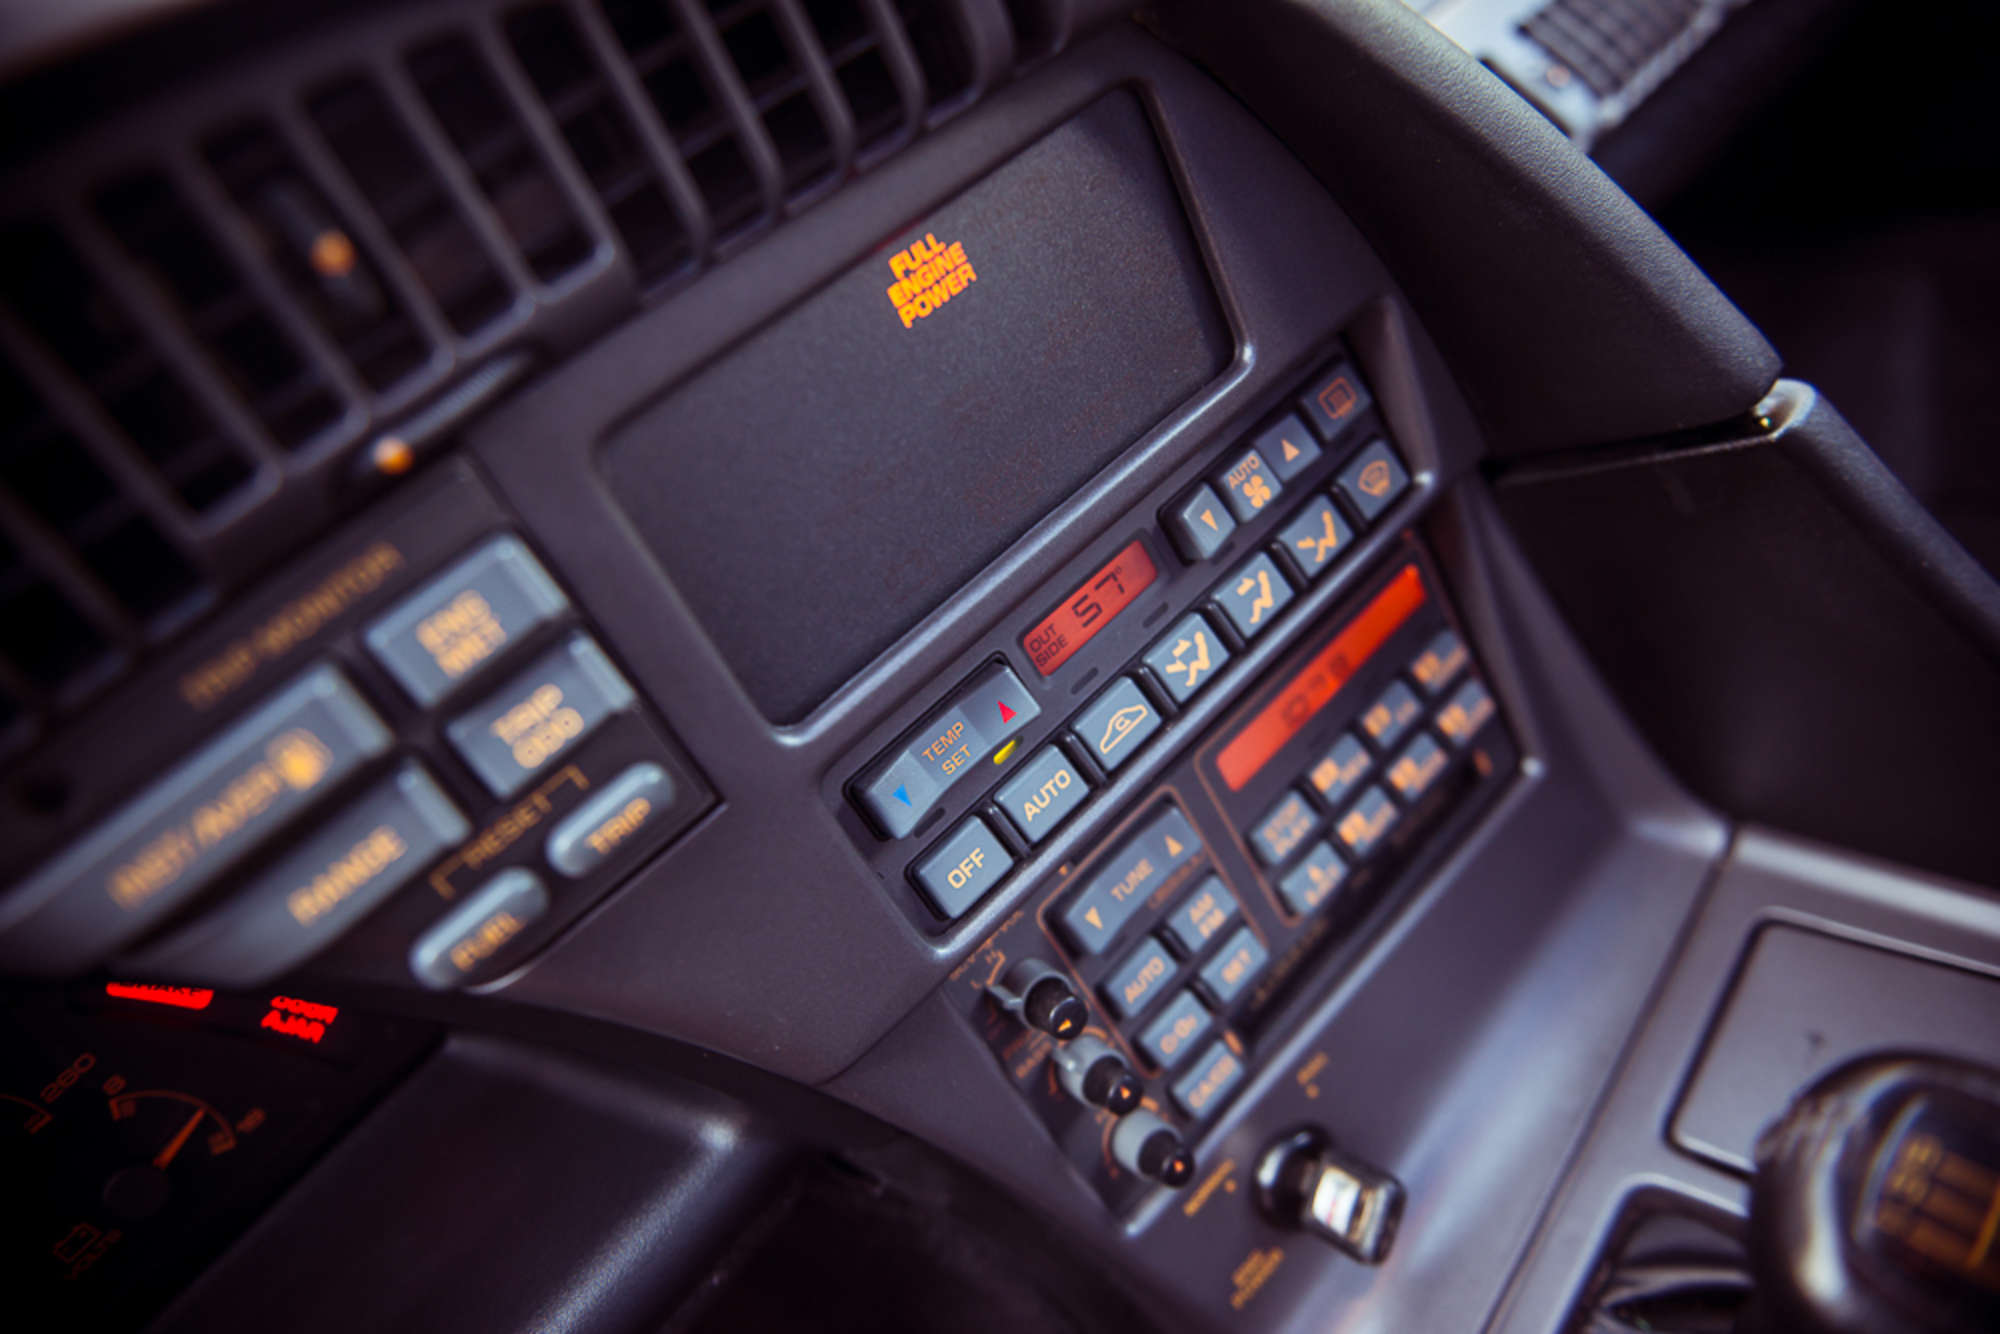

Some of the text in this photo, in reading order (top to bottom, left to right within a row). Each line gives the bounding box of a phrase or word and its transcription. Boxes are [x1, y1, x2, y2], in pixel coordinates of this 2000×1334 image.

[887, 241, 968, 309] ENGINE
[888, 232, 946, 281] FULL
[897, 262, 977, 328] POWER
[1227, 455, 1260, 490] AUTO
[1029, 623, 1058, 653] OUT
[1035, 635, 1069, 667] SIDE
[921, 721, 965, 763] TEMP
[941, 745, 972, 775] SET
[1023, 769, 1072, 822] AUTO
[464, 790, 552, 872] RESET
[584, 797, 651, 856] TRIP
[947, 847, 986, 889] OFF
[1110, 857, 1153, 902] TUNE
[1124, 957, 1165, 1004] AUTO
